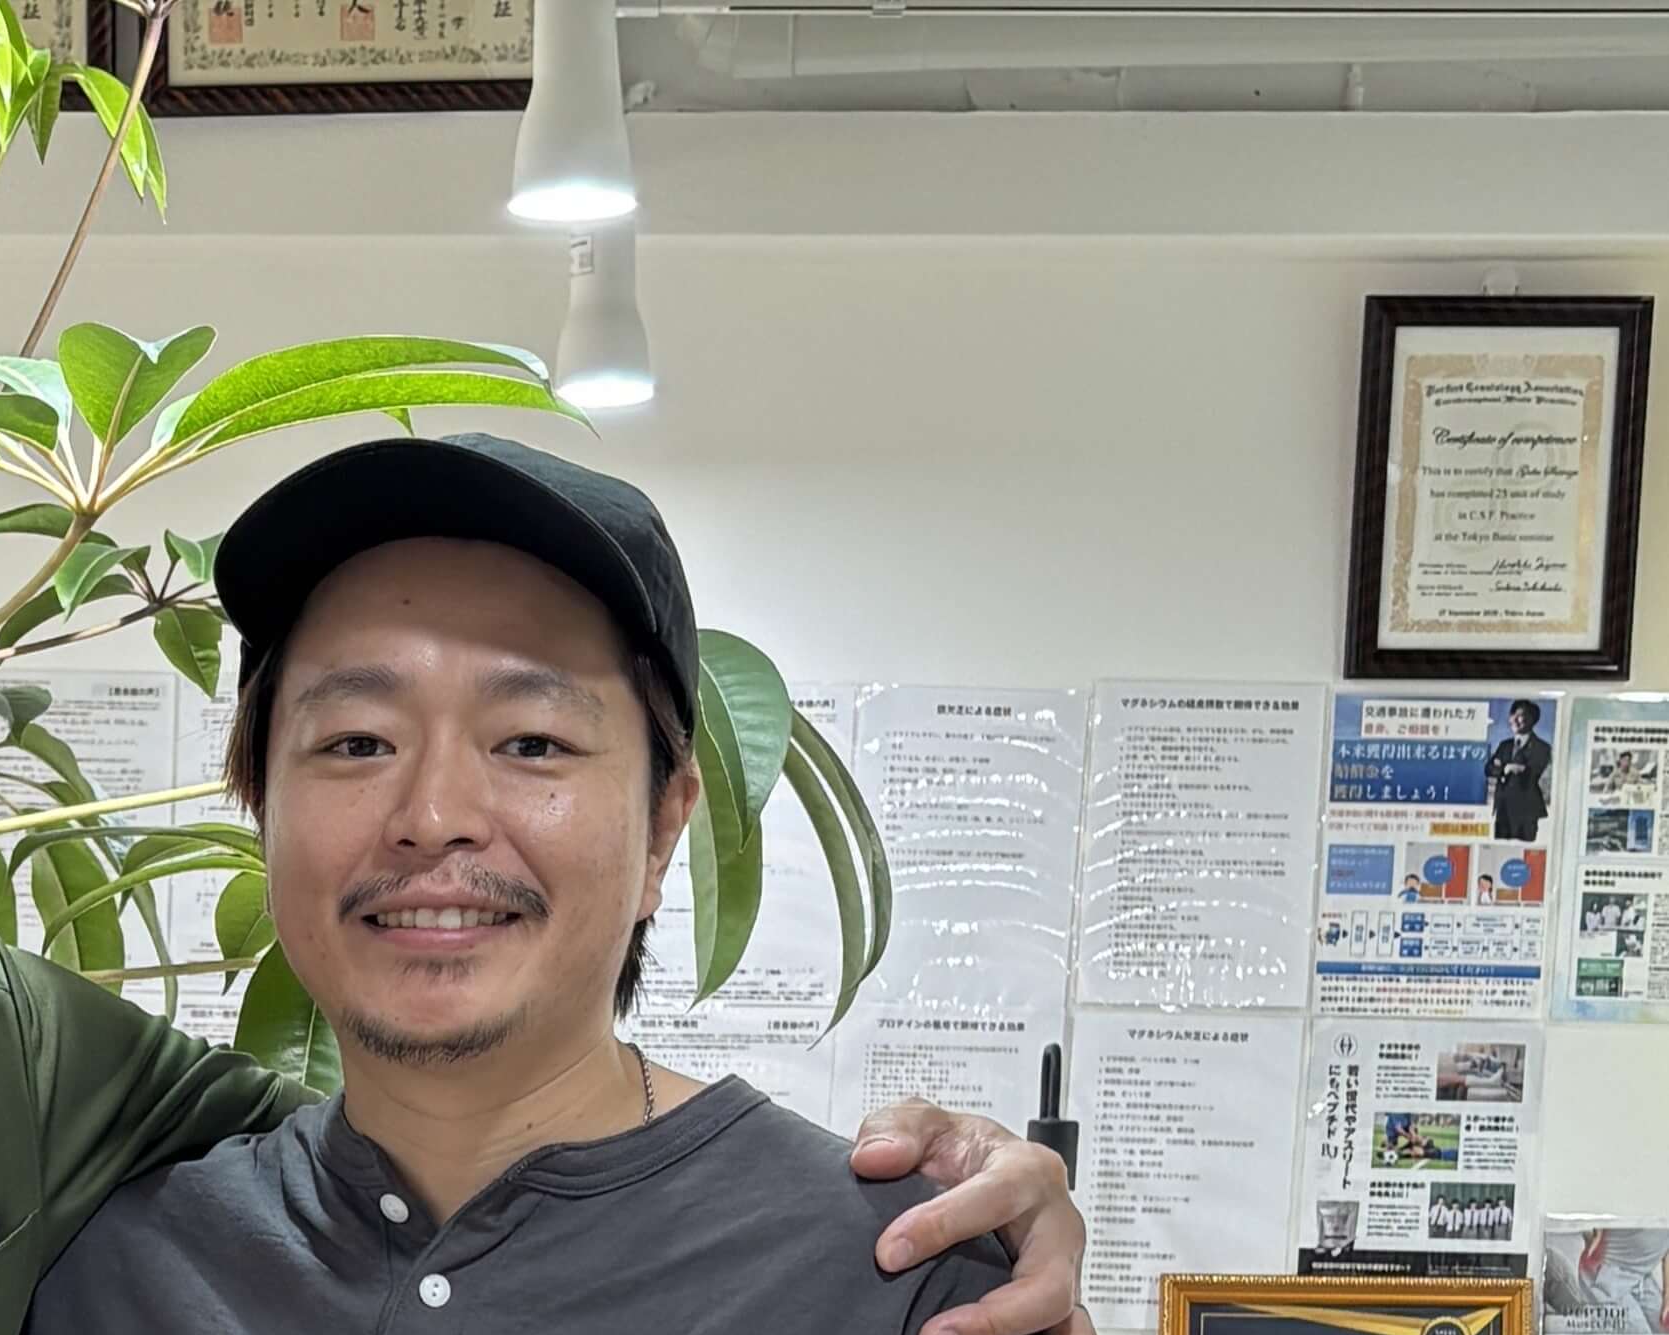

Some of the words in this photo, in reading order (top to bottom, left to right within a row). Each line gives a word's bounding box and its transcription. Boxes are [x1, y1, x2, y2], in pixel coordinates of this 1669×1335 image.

[1432, 427, 1496, 450] Certificate
[1497, 432, 1514, 450] of
[1422, 466, 1441, 476] This
[1443, 467, 1452, 476] is
[1453, 467, 1463, 476] to
[1464, 466, 1494, 478] certify
[1496, 466, 1512, 476] that
[1430, 488, 1445, 498] has
[1447, 488, 1493, 500] completed
[1528, 489, 1540, 498] of
[1542, 489, 1565, 500] study
[1458, 511, 1467, 520] in
[1500, 510, 1536, 520] Practice
[1434, 532, 1443, 541] at
[1445, 532, 1459, 541] the
[1462, 532, 1490, 544] Tokyo
[1342, 1064, 1359, 1190] 若い世代やアスリート
